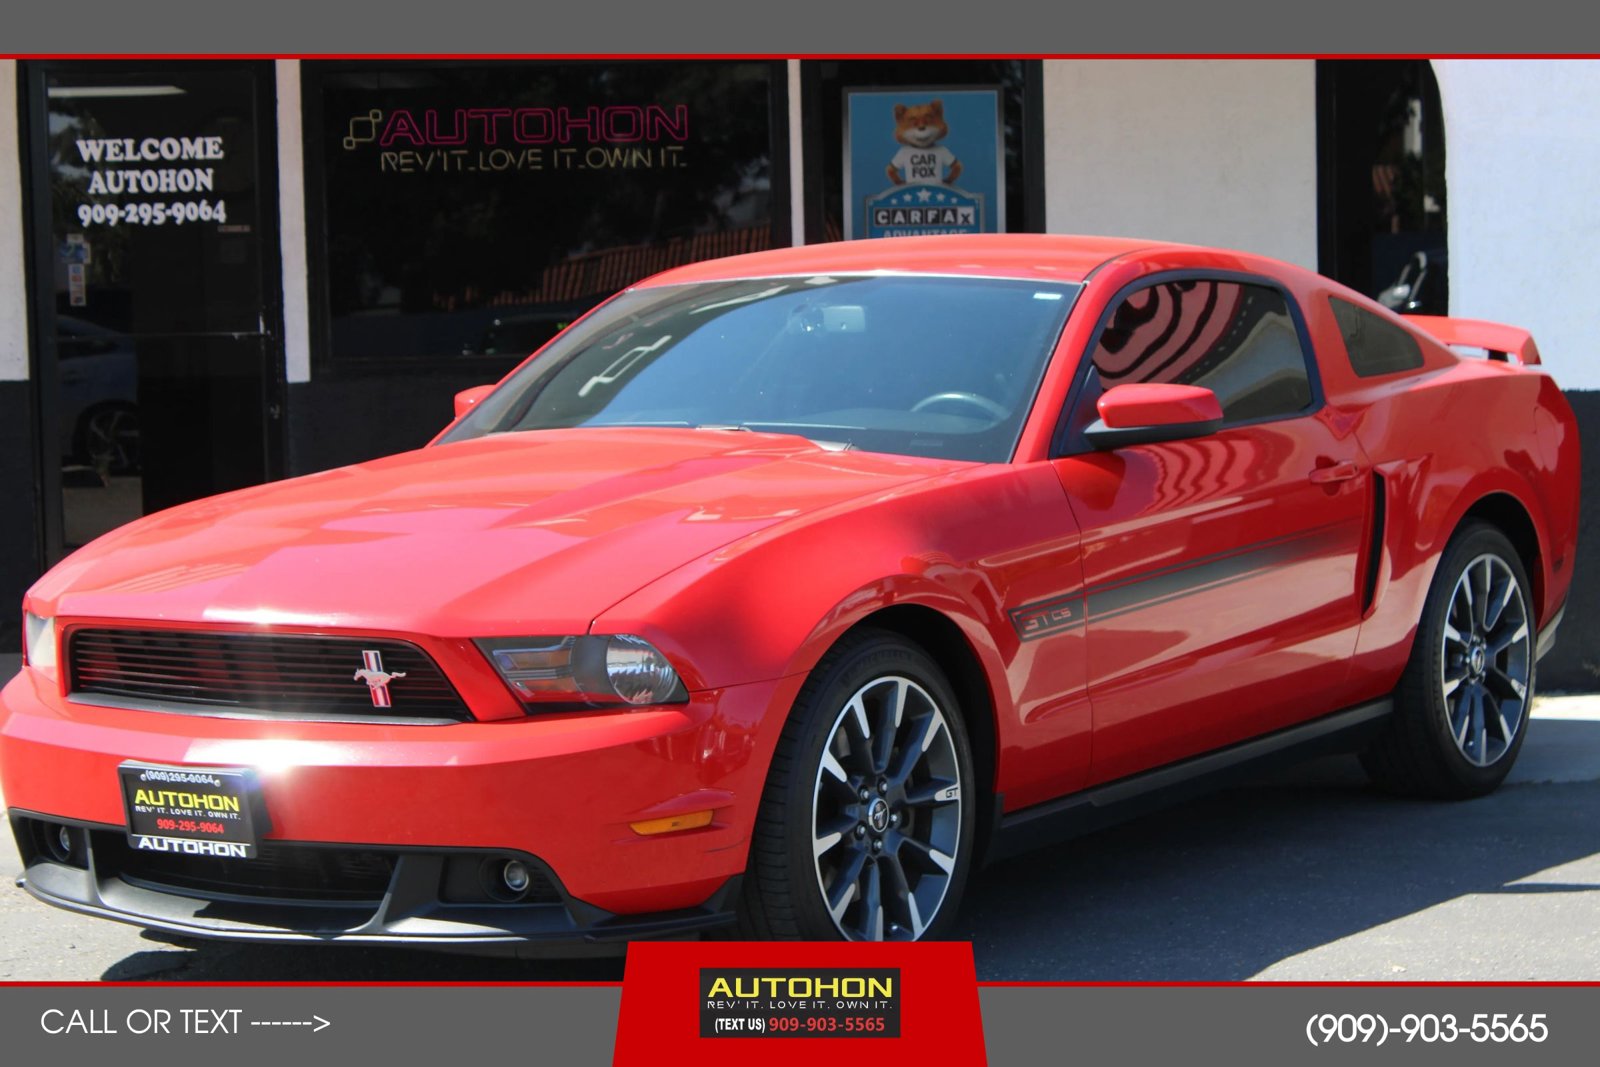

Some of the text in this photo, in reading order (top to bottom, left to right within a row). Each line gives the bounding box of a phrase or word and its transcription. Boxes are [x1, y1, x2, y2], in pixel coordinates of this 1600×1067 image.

[380, 104, 688, 146] AUTOHON
[76, 136, 224, 162] WELCOME
[479, 149, 543, 171] LOVE
[586, 147, 652, 168] OWN
[910, 154, 937, 166] CAR
[88, 168, 214, 194] AUTOHON
[911, 167, 937, 178] FOX
[77, 200, 227, 227] 909-295-9064
[876, 208, 972, 225] CARFAX
[145, 770, 214, 785] (909)295-9064
[134, 789, 241, 812] AUTOHON
[945, 787, 958, 798] GT
[170, 809, 193, 817] LOVE
[207, 811, 228, 819] OWN
[156, 818, 225, 834] 909-295-9064
[138, 837, 247, 858] AUTOHON
